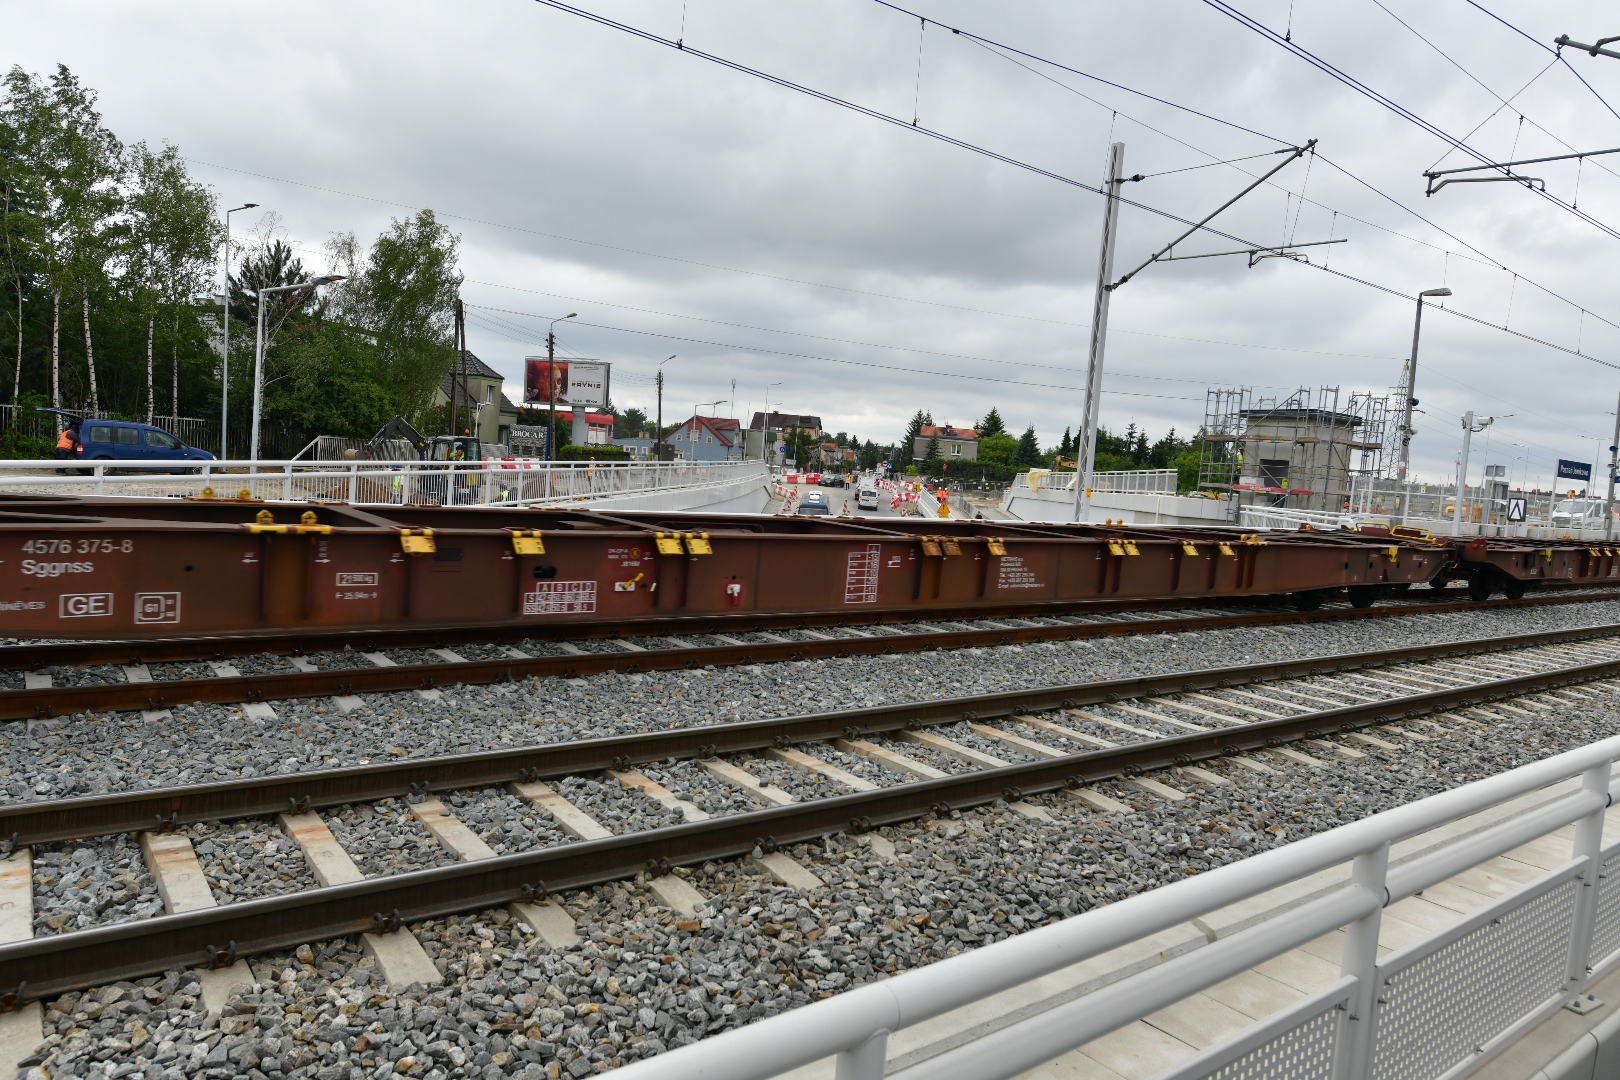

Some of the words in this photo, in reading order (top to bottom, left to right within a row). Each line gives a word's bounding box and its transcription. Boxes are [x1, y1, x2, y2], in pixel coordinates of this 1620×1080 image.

[21, 539, 73, 554] 4576
[76, 539, 134, 553] 375-8
[21, 559, 94, 578] Sggnss
[542, 583, 548, 592] A
[557, 583, 563, 592] B
[571, 583, 578, 591] C
[585, 582, 592, 591] D
[67, 595, 106, 614] GE
[528, 594, 535, 603] S
[525, 604, 536, 613] SS
